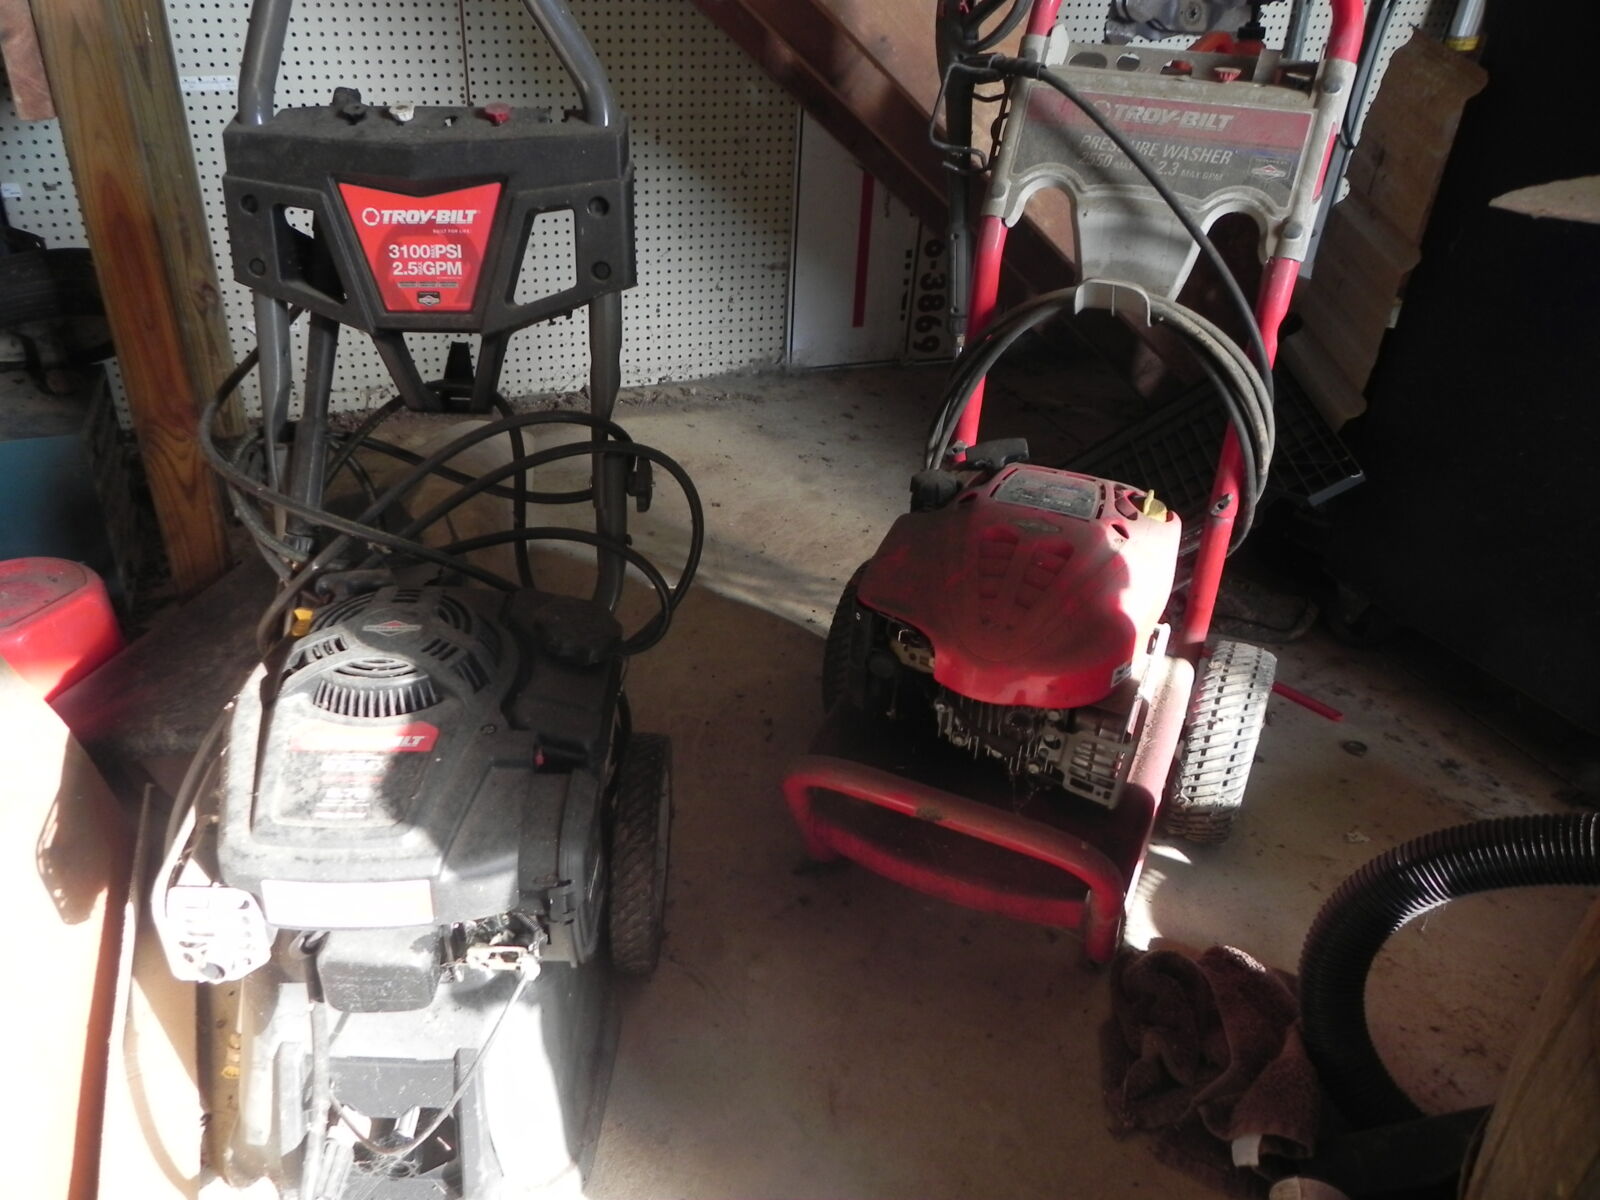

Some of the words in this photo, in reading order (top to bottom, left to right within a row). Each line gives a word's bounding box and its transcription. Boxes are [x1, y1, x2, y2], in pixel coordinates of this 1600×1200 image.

[1111, 104, 1234, 131] TROY-BILT
[1080, 135, 1160, 156] PRESURE
[1162, 143, 1233, 165] WASHER
[1157, 160, 1180, 177] 2.3
[1202, 171, 1225, 181] GPM
[380, 209, 477, 225] TROY-BILT
[388, 244, 431, 259] 3100
[435, 244, 462, 259] PSI
[392, 261, 418, 276] 2.5
[422, 261, 463, 276] GPM
